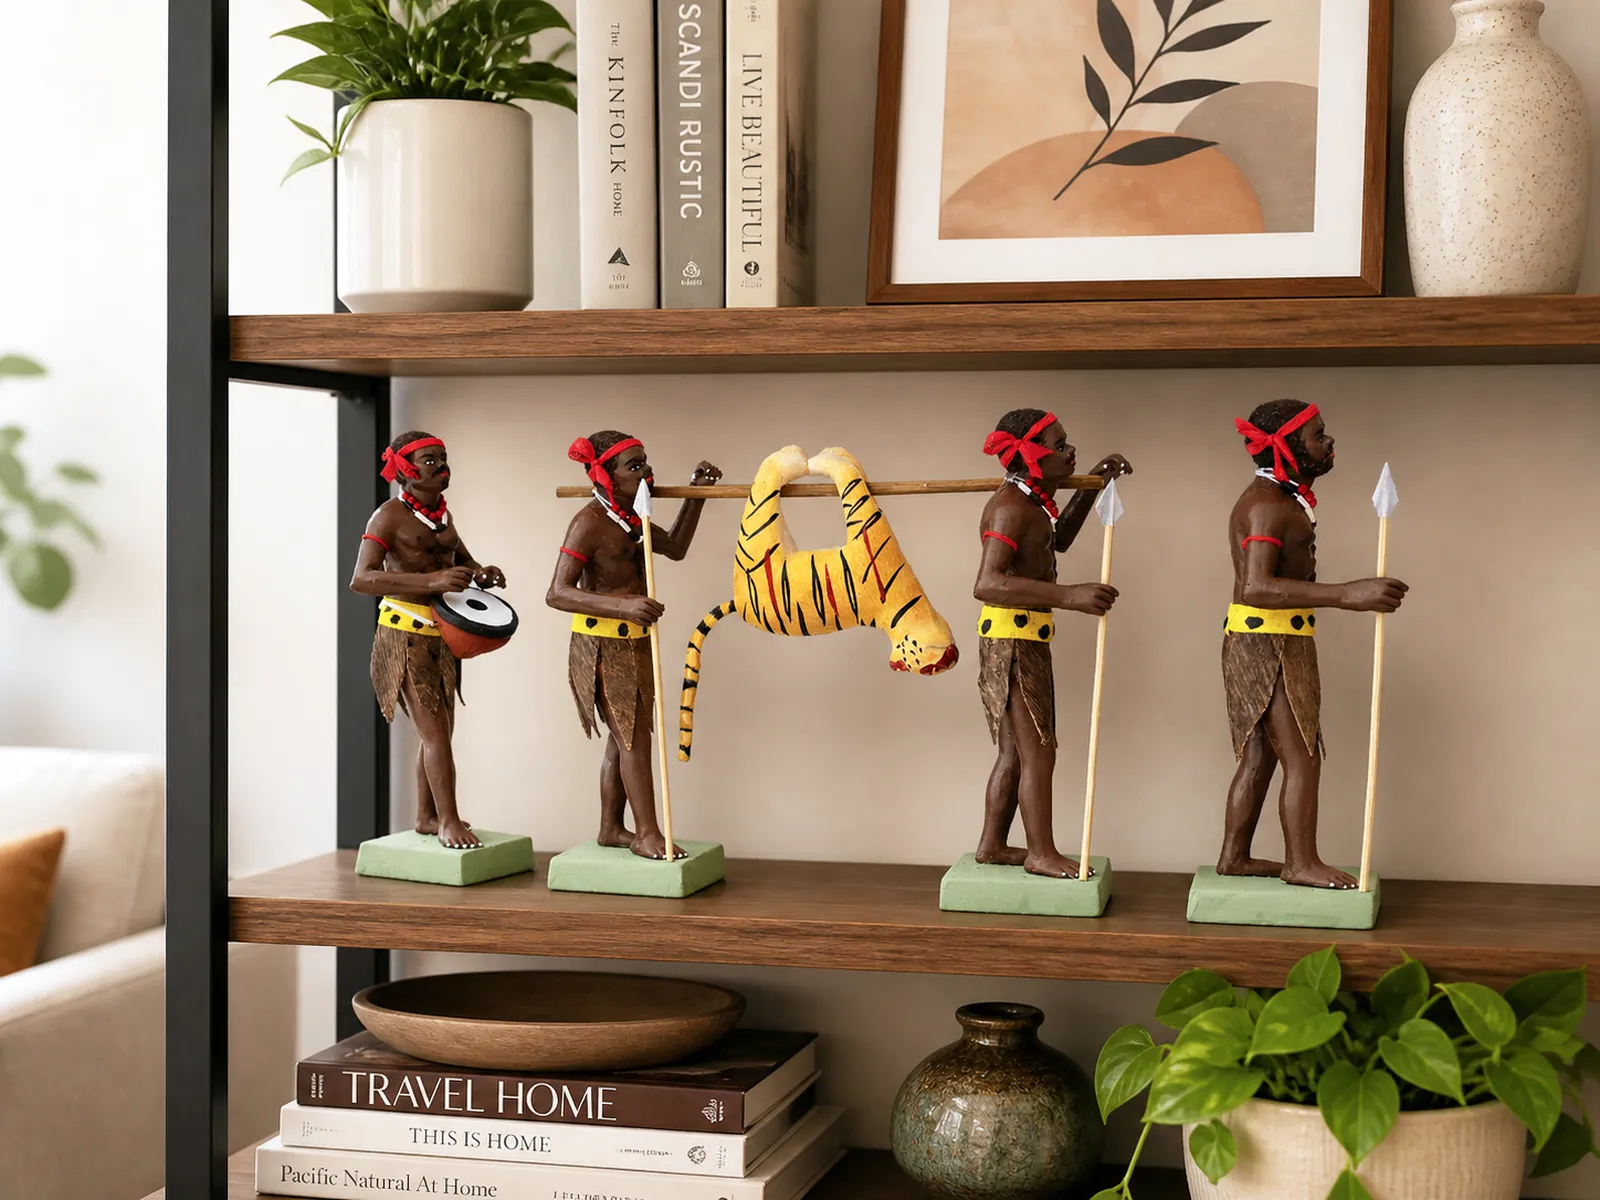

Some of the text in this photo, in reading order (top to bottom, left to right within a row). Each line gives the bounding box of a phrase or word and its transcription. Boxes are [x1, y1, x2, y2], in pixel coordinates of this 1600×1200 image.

[742, 54, 762, 108] LIVE
[608, 56, 626, 174] KINFOLK
[678, 4, 702, 220] SCANDI RUSTIC
[741, 116, 762, 252] BEAUTIFUL
[342, 1071, 485, 1113] TRAVEL
[497, 1082, 617, 1121] HOME
[409, 1128, 551, 1153] THIS IS HOME
[280, 1166, 497, 1198] Pacific Natural At Home
